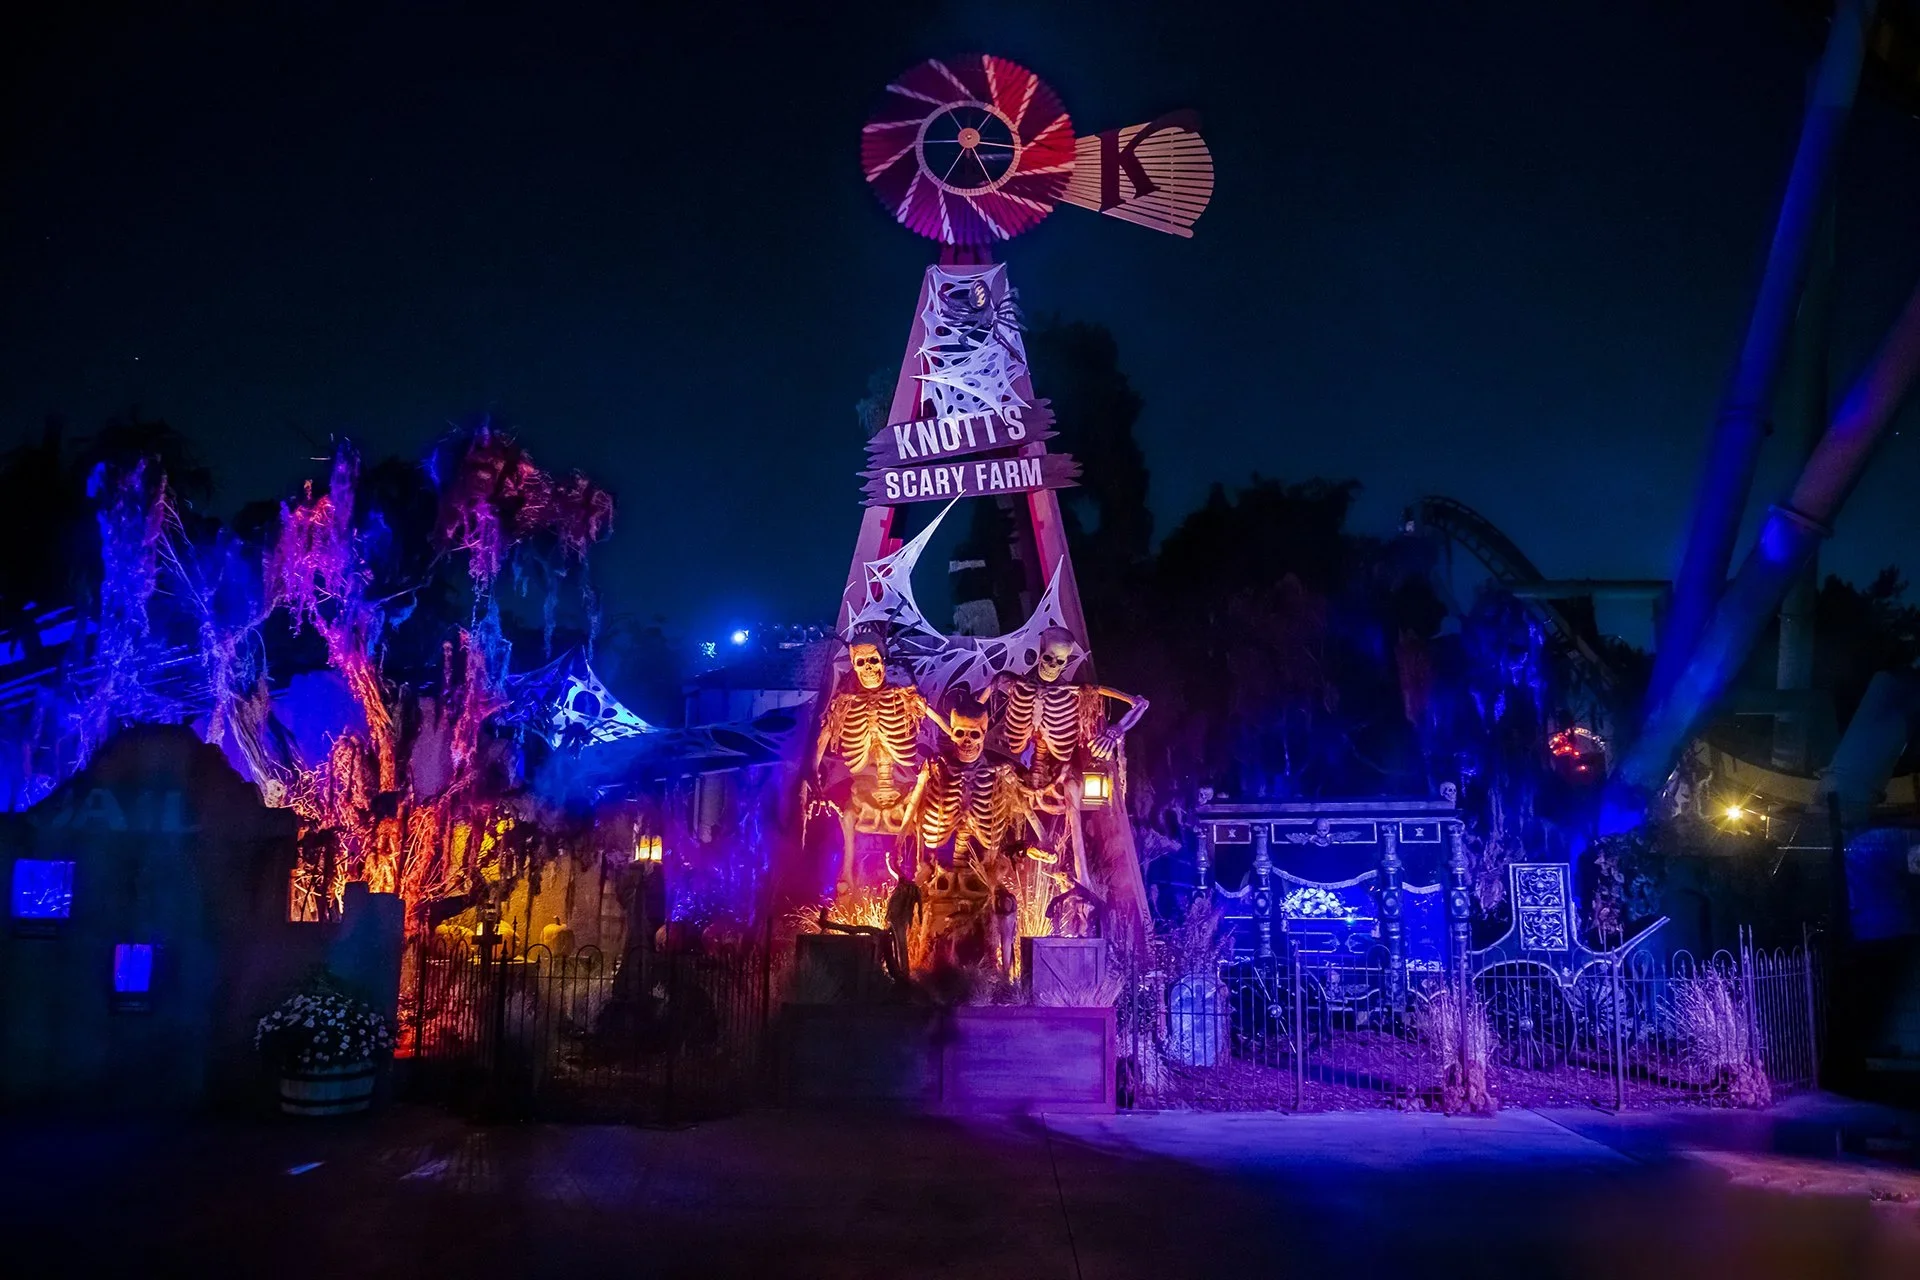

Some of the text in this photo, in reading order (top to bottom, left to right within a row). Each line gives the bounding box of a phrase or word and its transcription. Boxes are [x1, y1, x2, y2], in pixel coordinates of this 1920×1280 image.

[1095, 107, 1203, 212] K
[893, 405, 1026, 460] KNOTTS
[885, 457, 1043, 499] SCARY FARM
